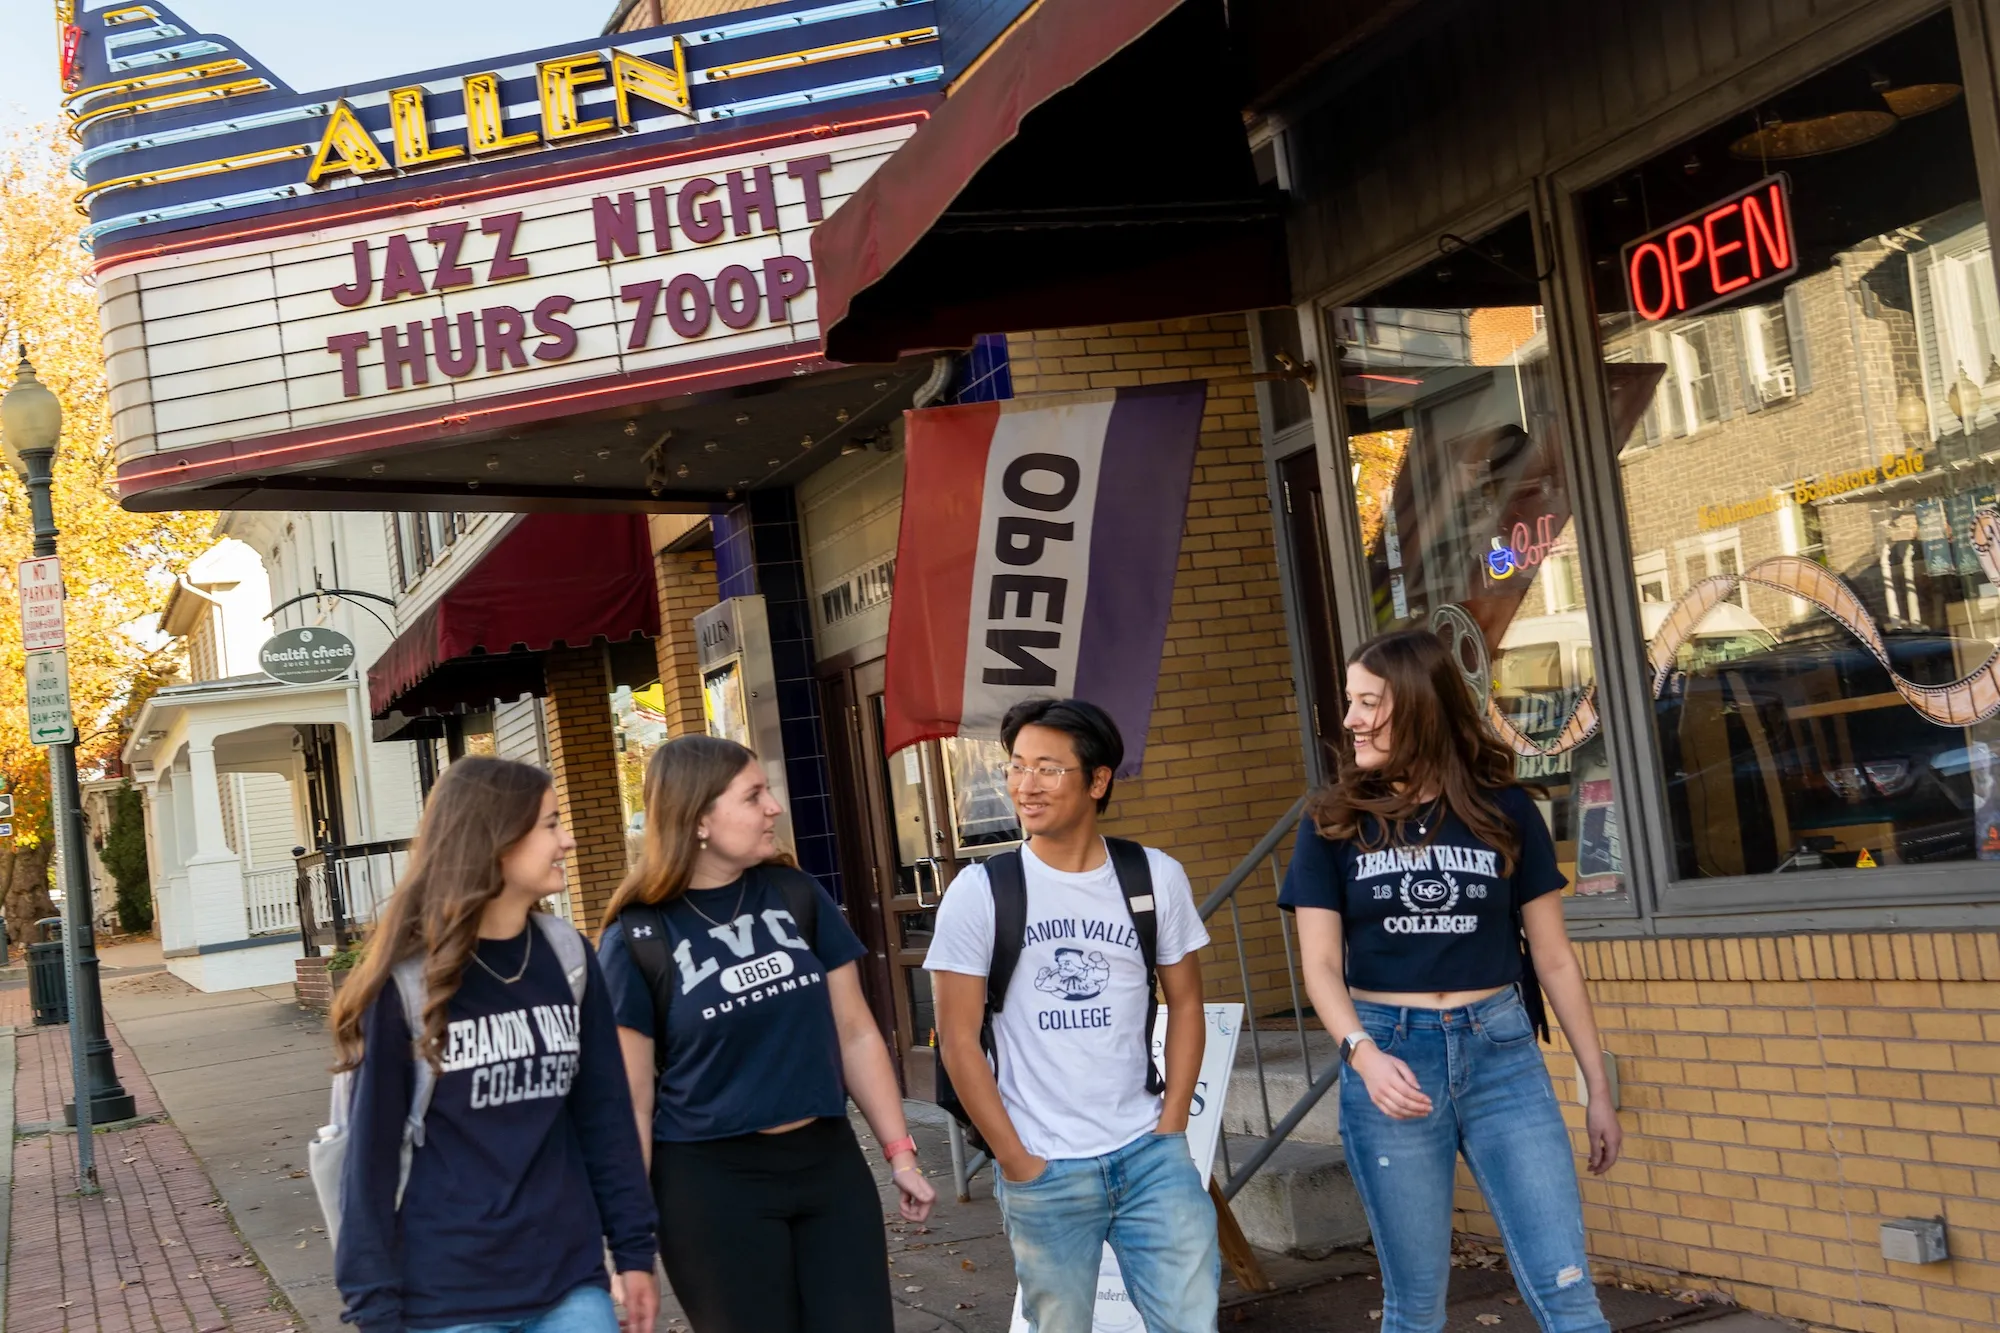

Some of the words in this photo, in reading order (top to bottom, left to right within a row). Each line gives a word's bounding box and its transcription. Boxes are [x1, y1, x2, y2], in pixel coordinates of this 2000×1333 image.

[306, 34, 698, 186] ALLEN
[331, 211, 529, 307] JAZZ
[592, 154, 832, 261] NIGHT
[1630, 184, 1789, 321] OPEN
[327, 295, 578, 397] THURS
[620, 255, 809, 349] 700P
[1795, 467, 1878, 504] Bookstore
[1510, 513, 1560, 571] Coff
[33, 564, 47, 581] NO
[23, 584, 59, 604] PARKING
[821, 558, 894, 625] WWW.ALLEN
[29, 604, 55, 617] FRIDAY
[702, 619, 730, 648] ALLEN
[38, 661, 54, 673] TWO
[262, 646, 310, 662] health
[311, 643, 353, 659] check
[283, 660, 310, 668] JUICE
[36, 677, 58, 690] HOUR
[32, 693, 65, 707] PARKING
[1355, 845, 1433, 881] LEBANON
[1432, 845, 1498, 878] VALLEY
[1372, 884, 1393, 899] 18
[1465, 884, 1487, 899] 66
[1021, 918, 1075, 949] ANON
[1383, 915, 1478, 933] COLLEGE
[672, 908, 810, 995] LVC
[733, 956, 782, 987] 1866
[702, 972, 821, 1020] DUTCHMEN
[1038, 1006, 1112, 1031] COLLEGE
